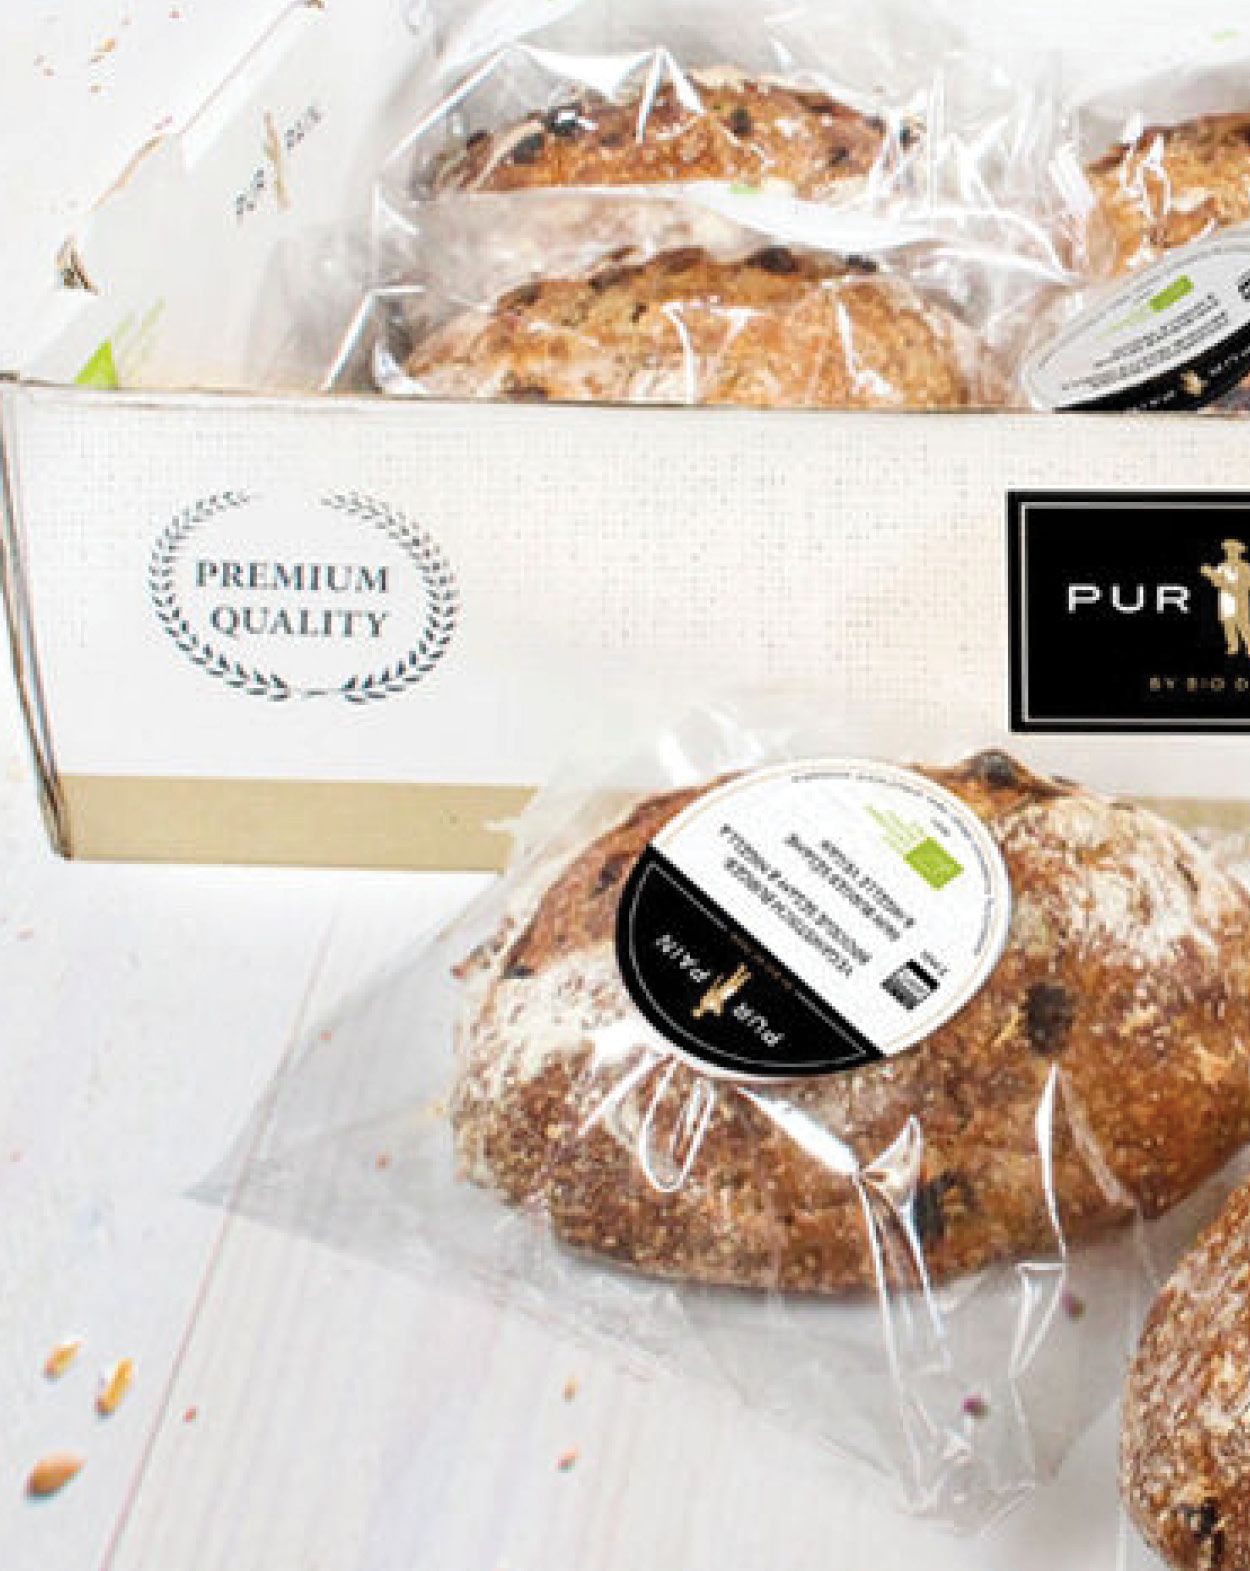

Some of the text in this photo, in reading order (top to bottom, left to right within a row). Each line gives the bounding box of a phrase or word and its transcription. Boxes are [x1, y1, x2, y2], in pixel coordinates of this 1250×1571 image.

[195, 560, 390, 593] PREMIUM
[1067, 583, 1192, 615] PUR
[210, 606, 390, 638] QUALITY
[653, 931, 712, 983] PAIN
[730, 1001, 785, 1047] PUR
